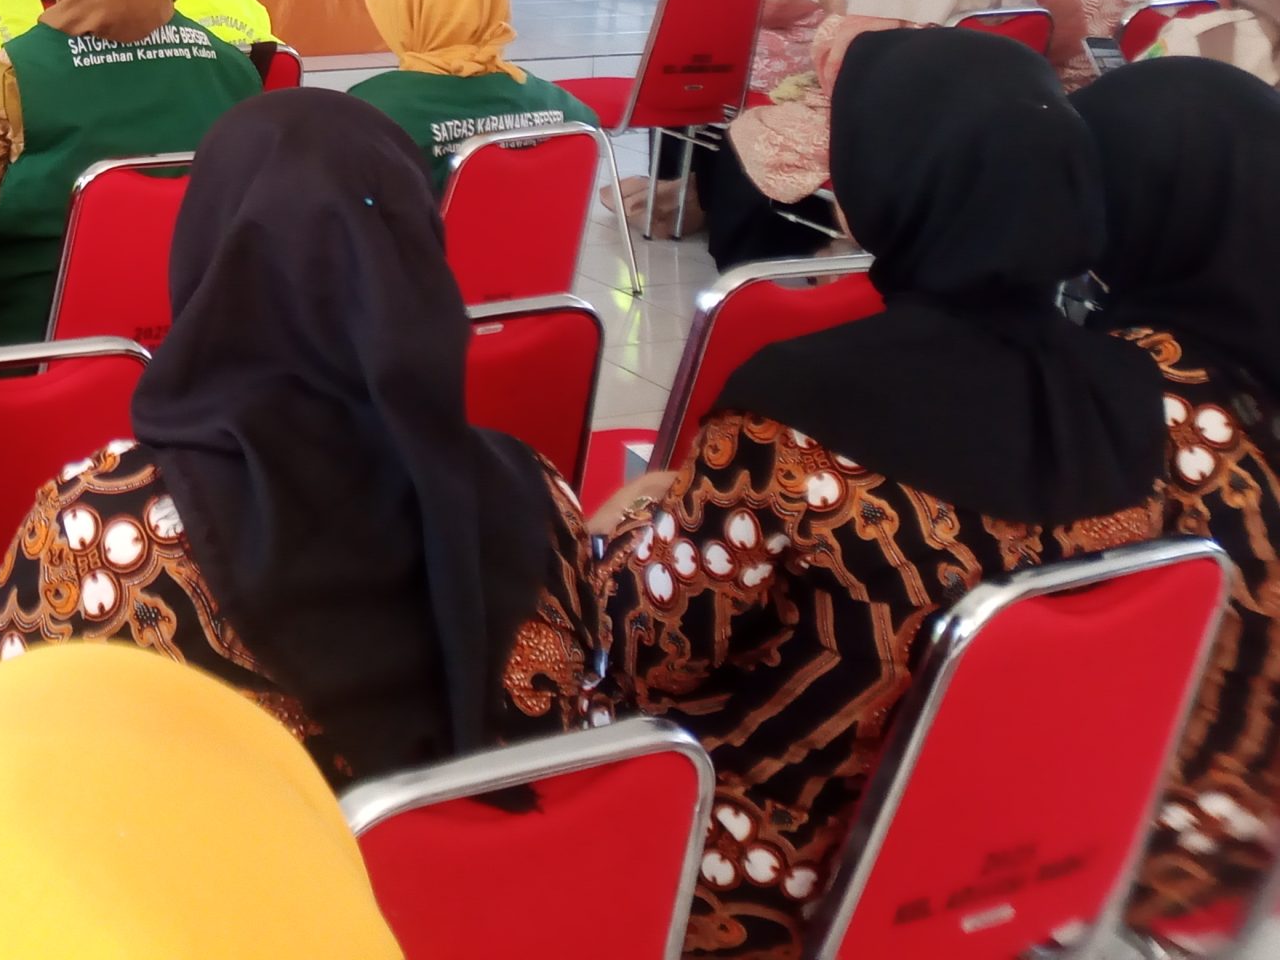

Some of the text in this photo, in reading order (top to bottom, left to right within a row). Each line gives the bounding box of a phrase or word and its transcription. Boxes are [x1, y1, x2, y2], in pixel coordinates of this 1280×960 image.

[72, 45, 217, 67] Kelurahan Karawang Kulon
[431, 119, 475, 143] SATGAS
[477, 113, 533, 135] KARAWANG
